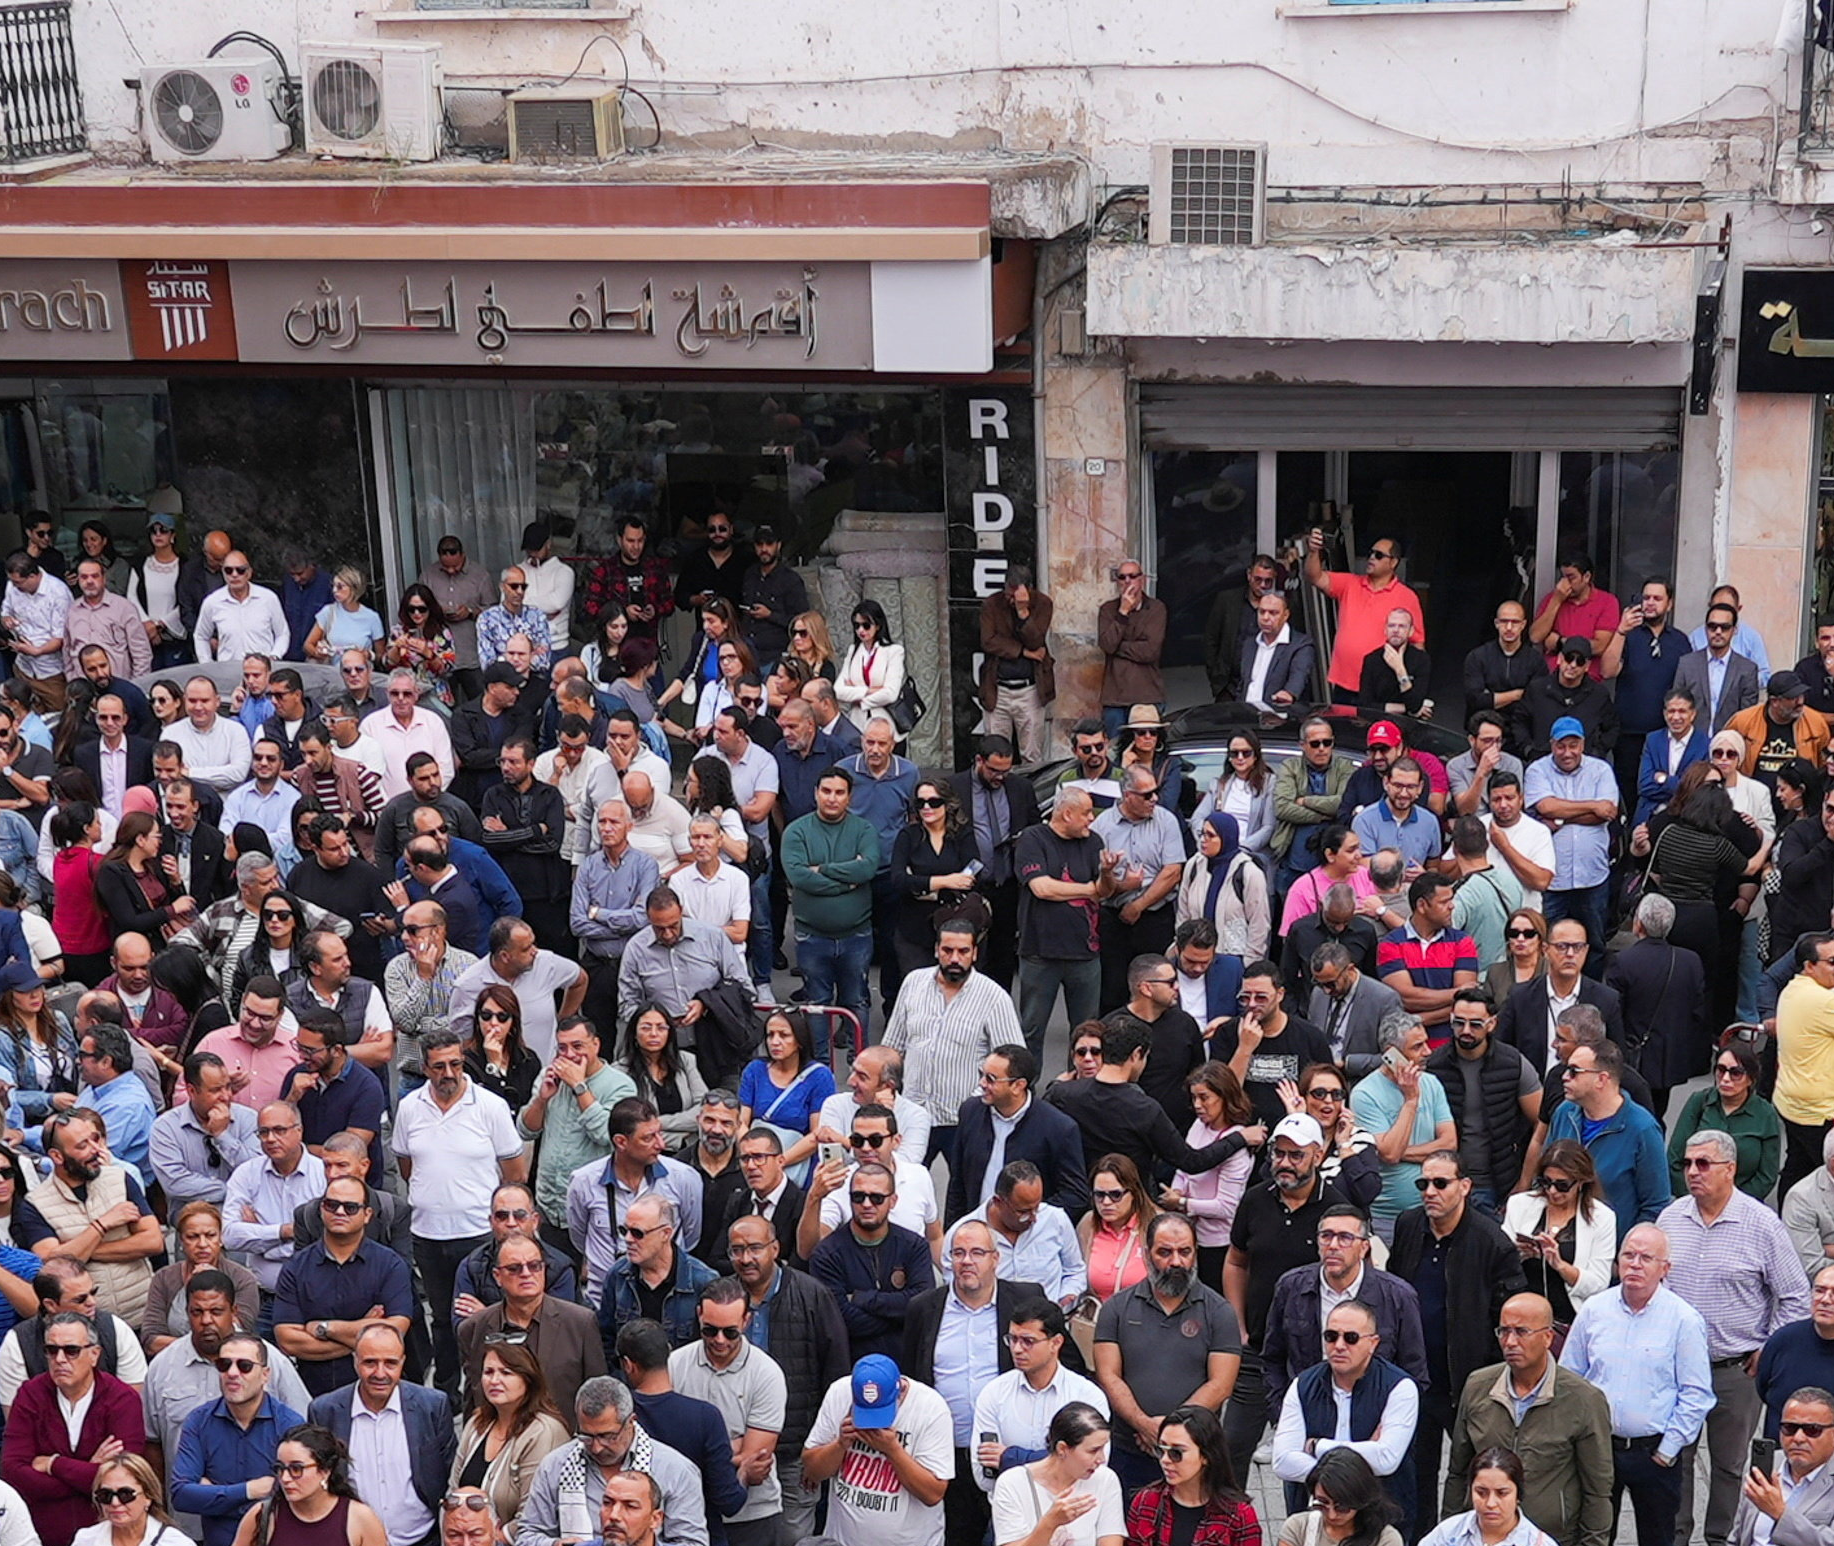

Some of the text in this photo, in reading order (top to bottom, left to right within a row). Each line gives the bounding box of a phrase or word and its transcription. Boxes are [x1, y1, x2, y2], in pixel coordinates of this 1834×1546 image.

[235, 98, 250, 109] LG
[474, 276, 657, 366] لطفي
[669, 266, 820, 360] أقمشة
[1088, 462, 1101, 471] 20
